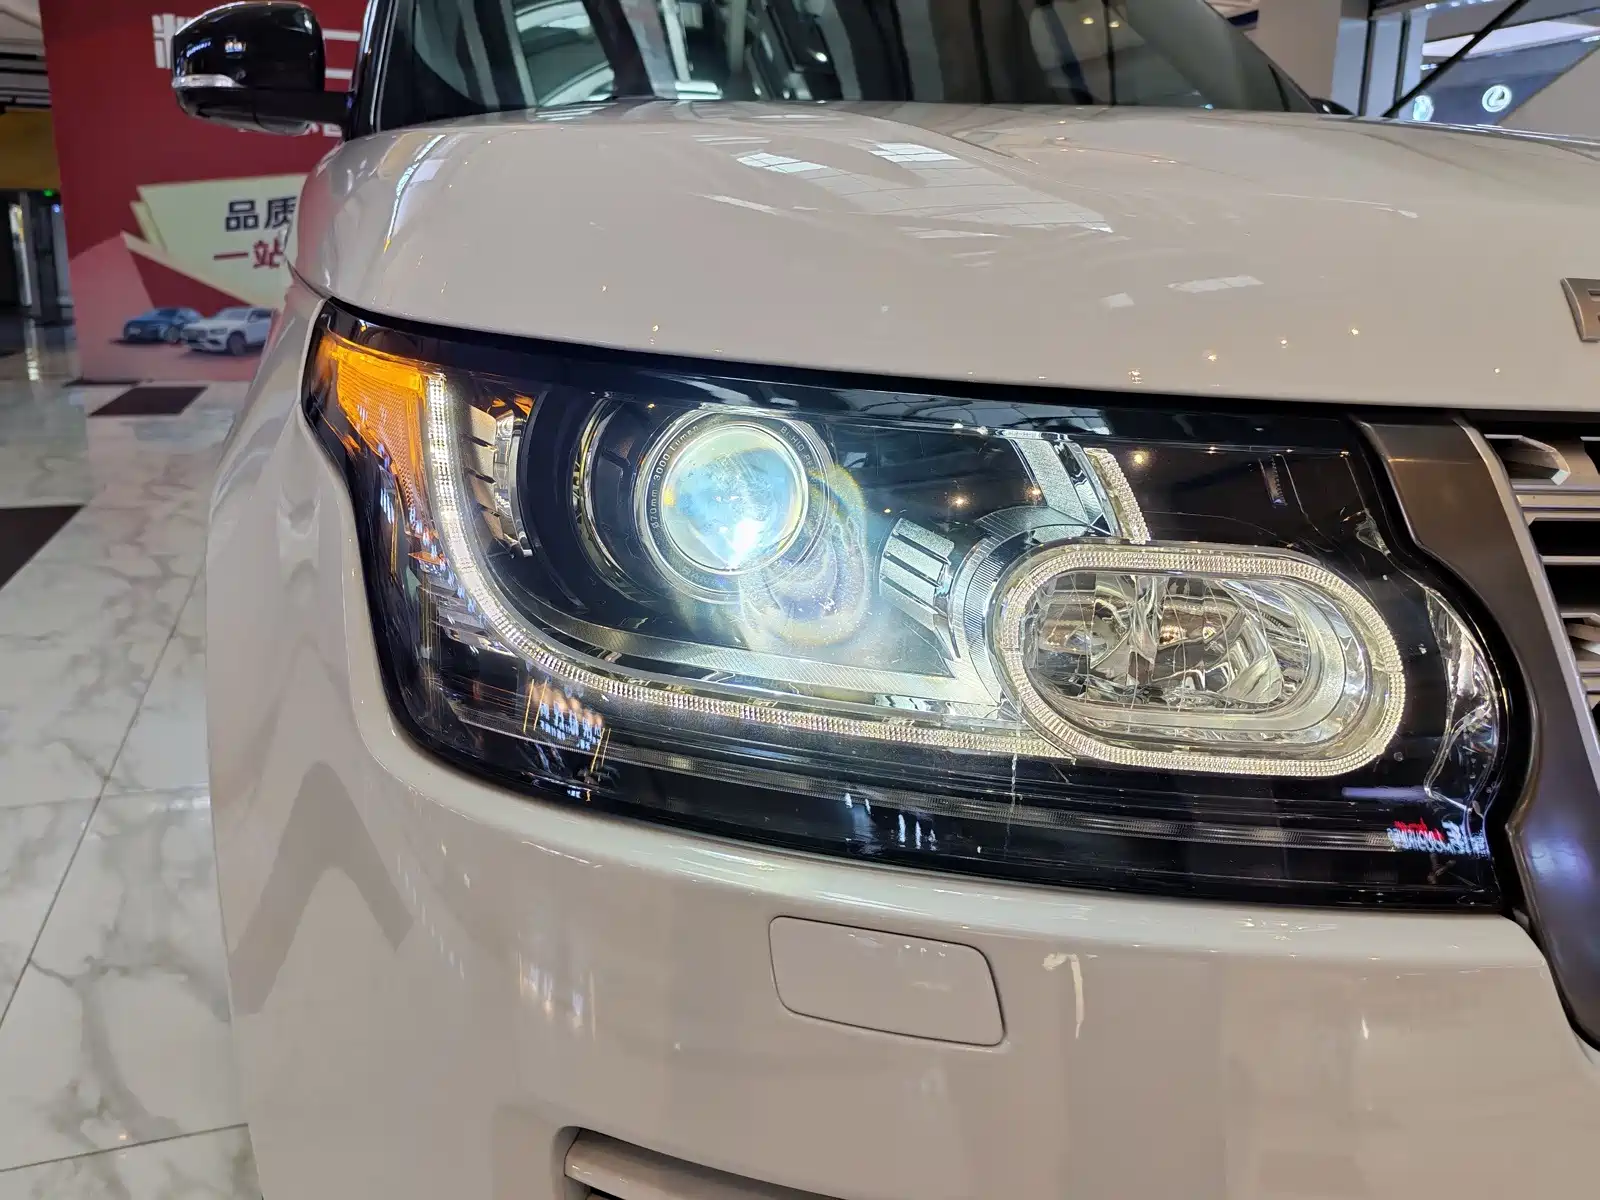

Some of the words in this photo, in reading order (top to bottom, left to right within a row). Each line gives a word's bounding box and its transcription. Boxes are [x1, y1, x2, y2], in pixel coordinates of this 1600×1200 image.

[225, 196, 297, 232] 品质
[653, 453, 671, 481] 3000
[669, 425, 699, 451] Lumen
